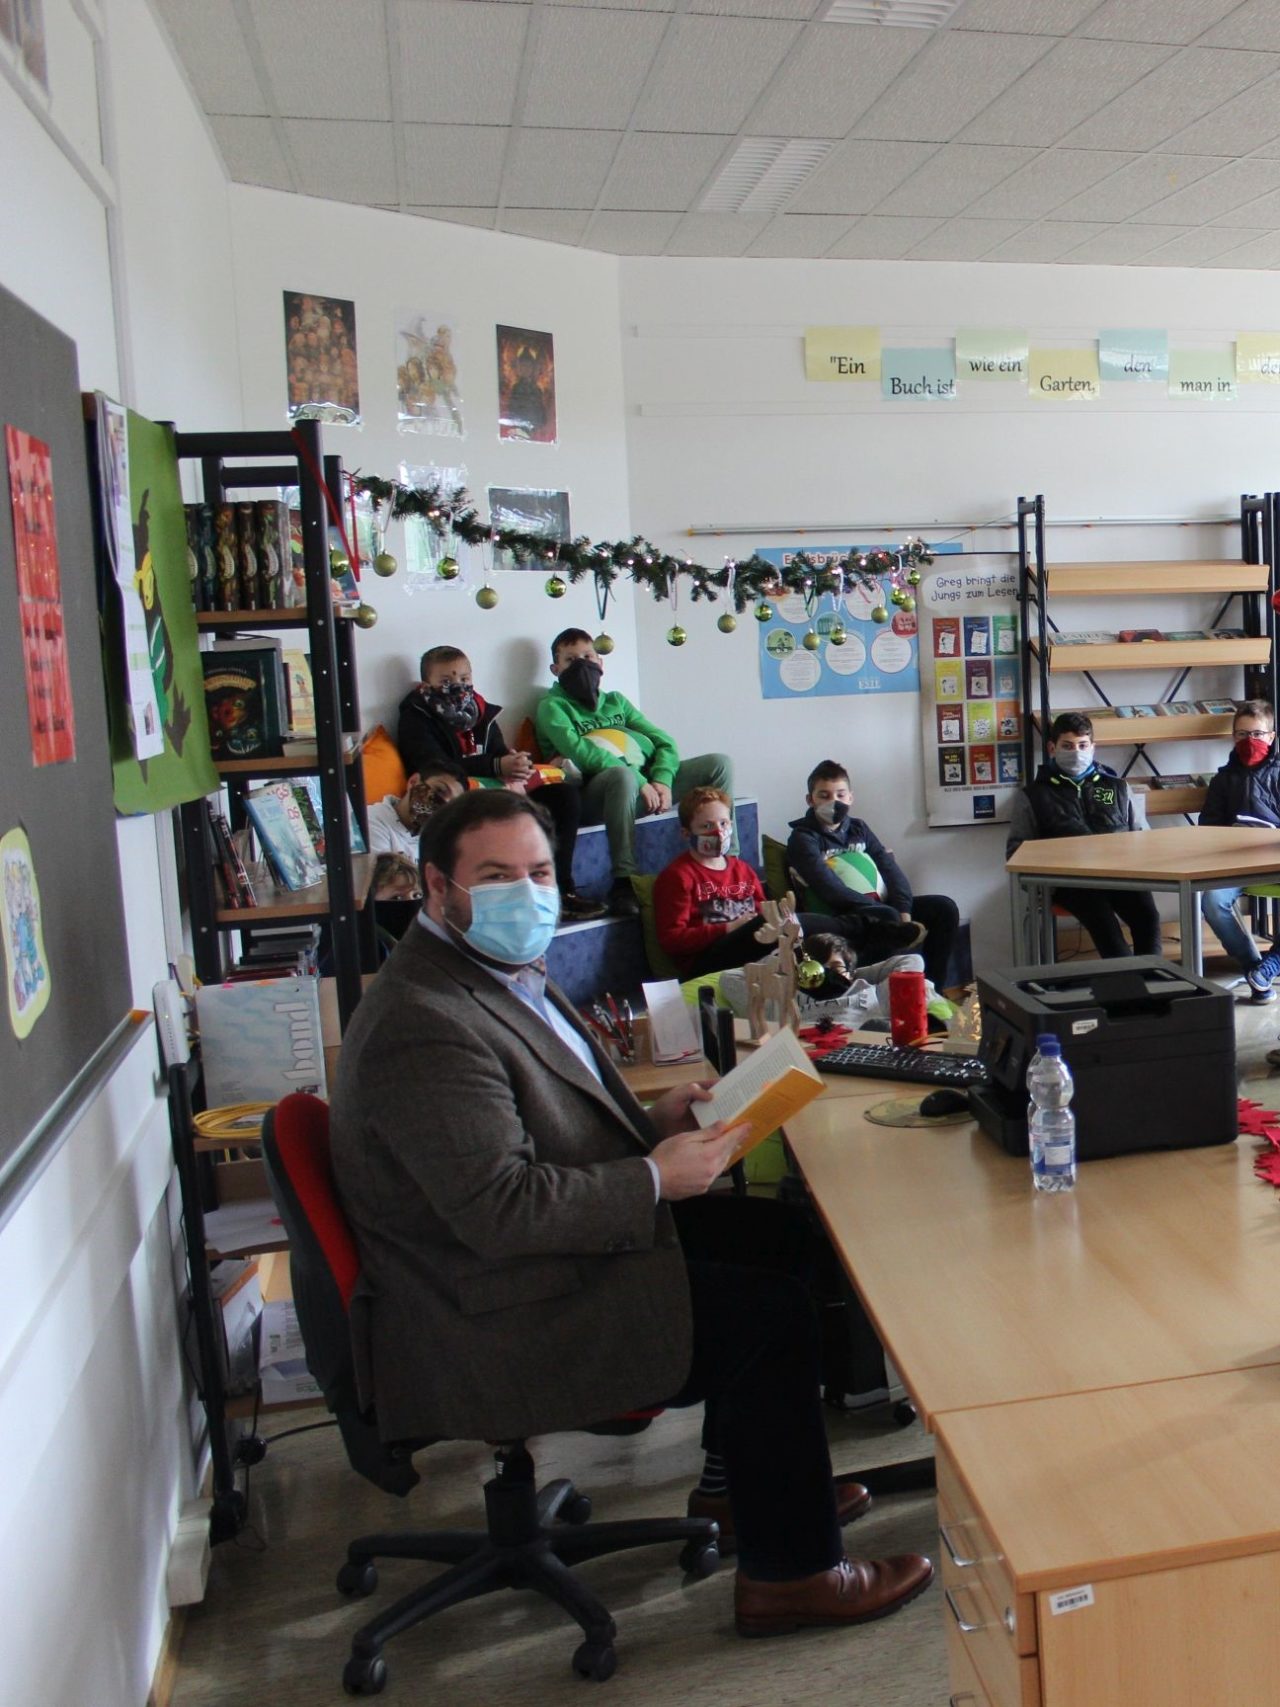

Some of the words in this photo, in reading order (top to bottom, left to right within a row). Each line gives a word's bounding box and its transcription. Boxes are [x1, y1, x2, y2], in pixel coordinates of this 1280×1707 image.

[830, 356, 866, 374] "Ein
[969, 357, 994, 371] wie
[999, 357, 1022, 372] ein
[1124, 354, 1152, 372] den
[890, 376, 932, 394] Buch
[937, 379, 954, 394] ist
[1040, 375, 1095, 392] Garten,
[1181, 380, 1212, 392] man
[1218, 378, 1232, 392] in
[937, 577, 962, 588] Greg
[966, 575, 996, 586] bringt
[1000, 575, 1015, 583] die
[932, 591, 960, 601] Jungs
[988, 588, 1018, 597] Lesen
